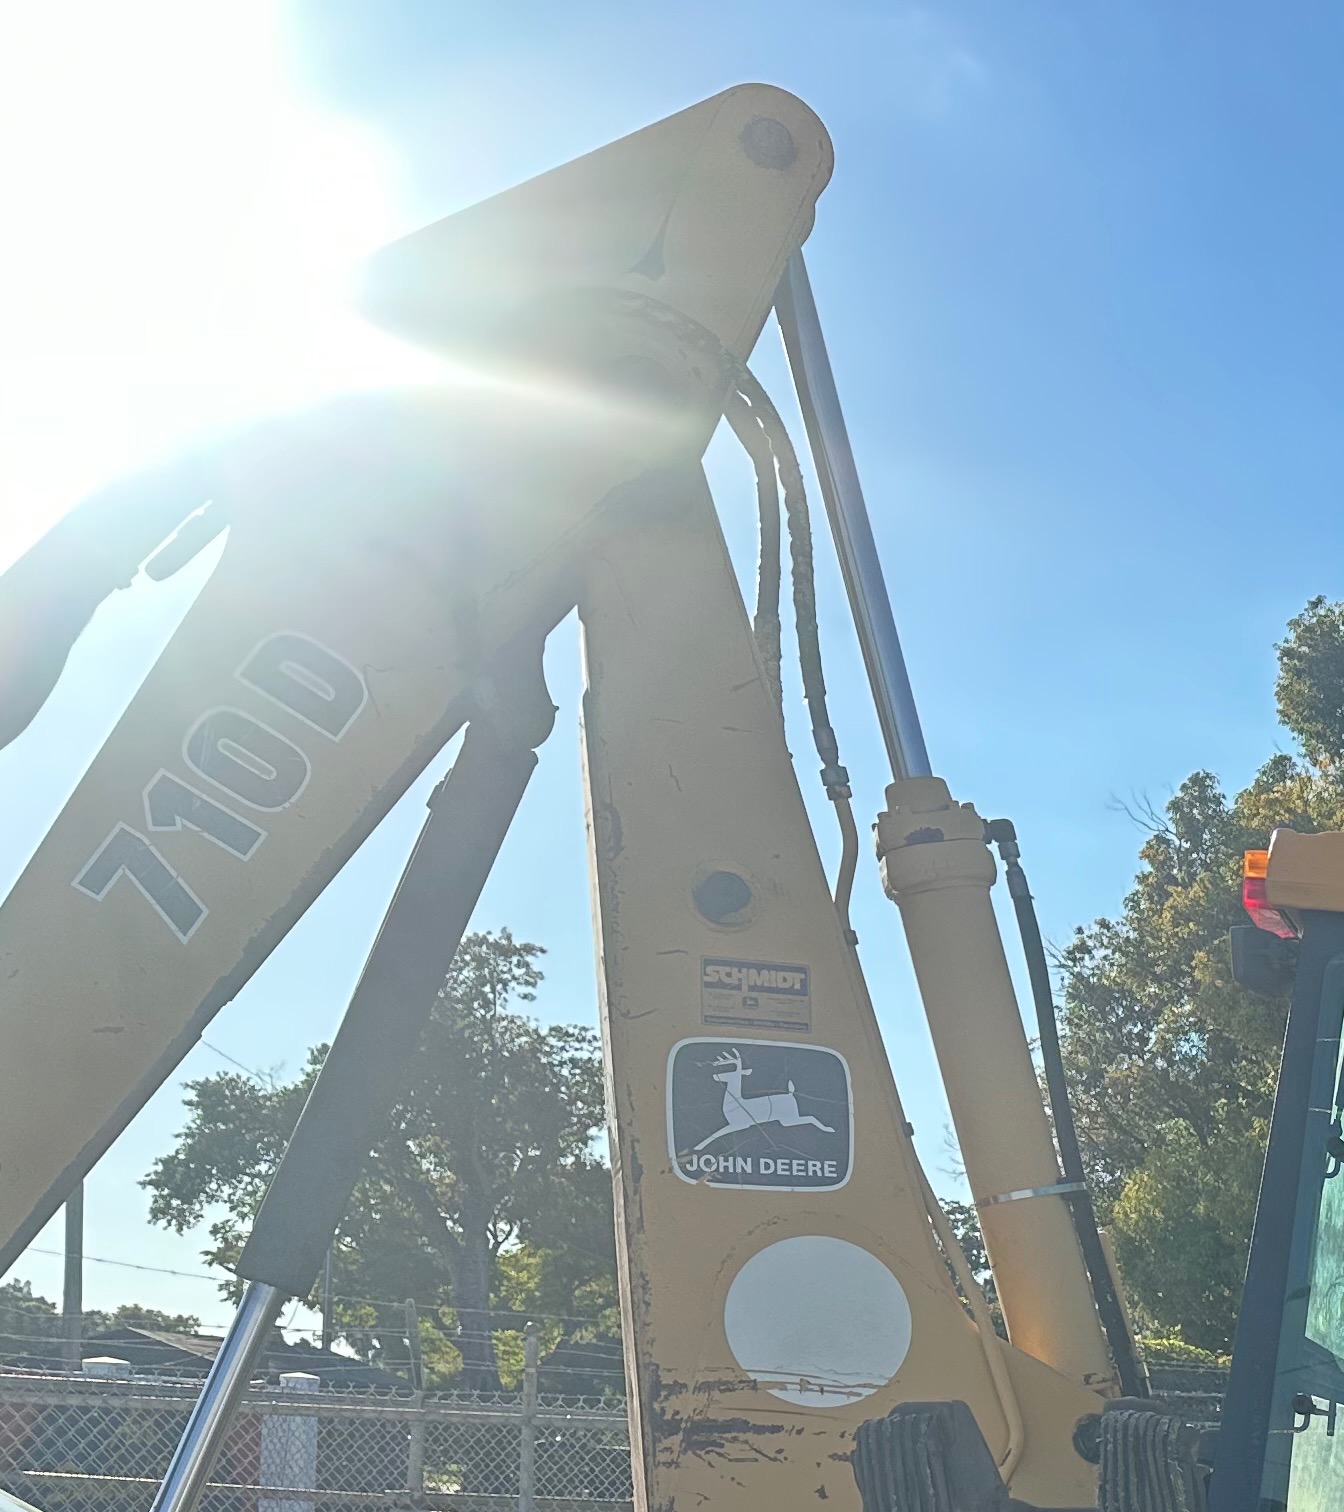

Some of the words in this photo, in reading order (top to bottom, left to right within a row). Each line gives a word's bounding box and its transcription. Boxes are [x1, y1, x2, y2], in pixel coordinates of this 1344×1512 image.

[71, 630, 369, 944] 710D
[703, 965, 806, 992] SCHMIDT
[686, 1154, 752, 1174] JOHN
[759, 1158, 838, 1178] DEERE
